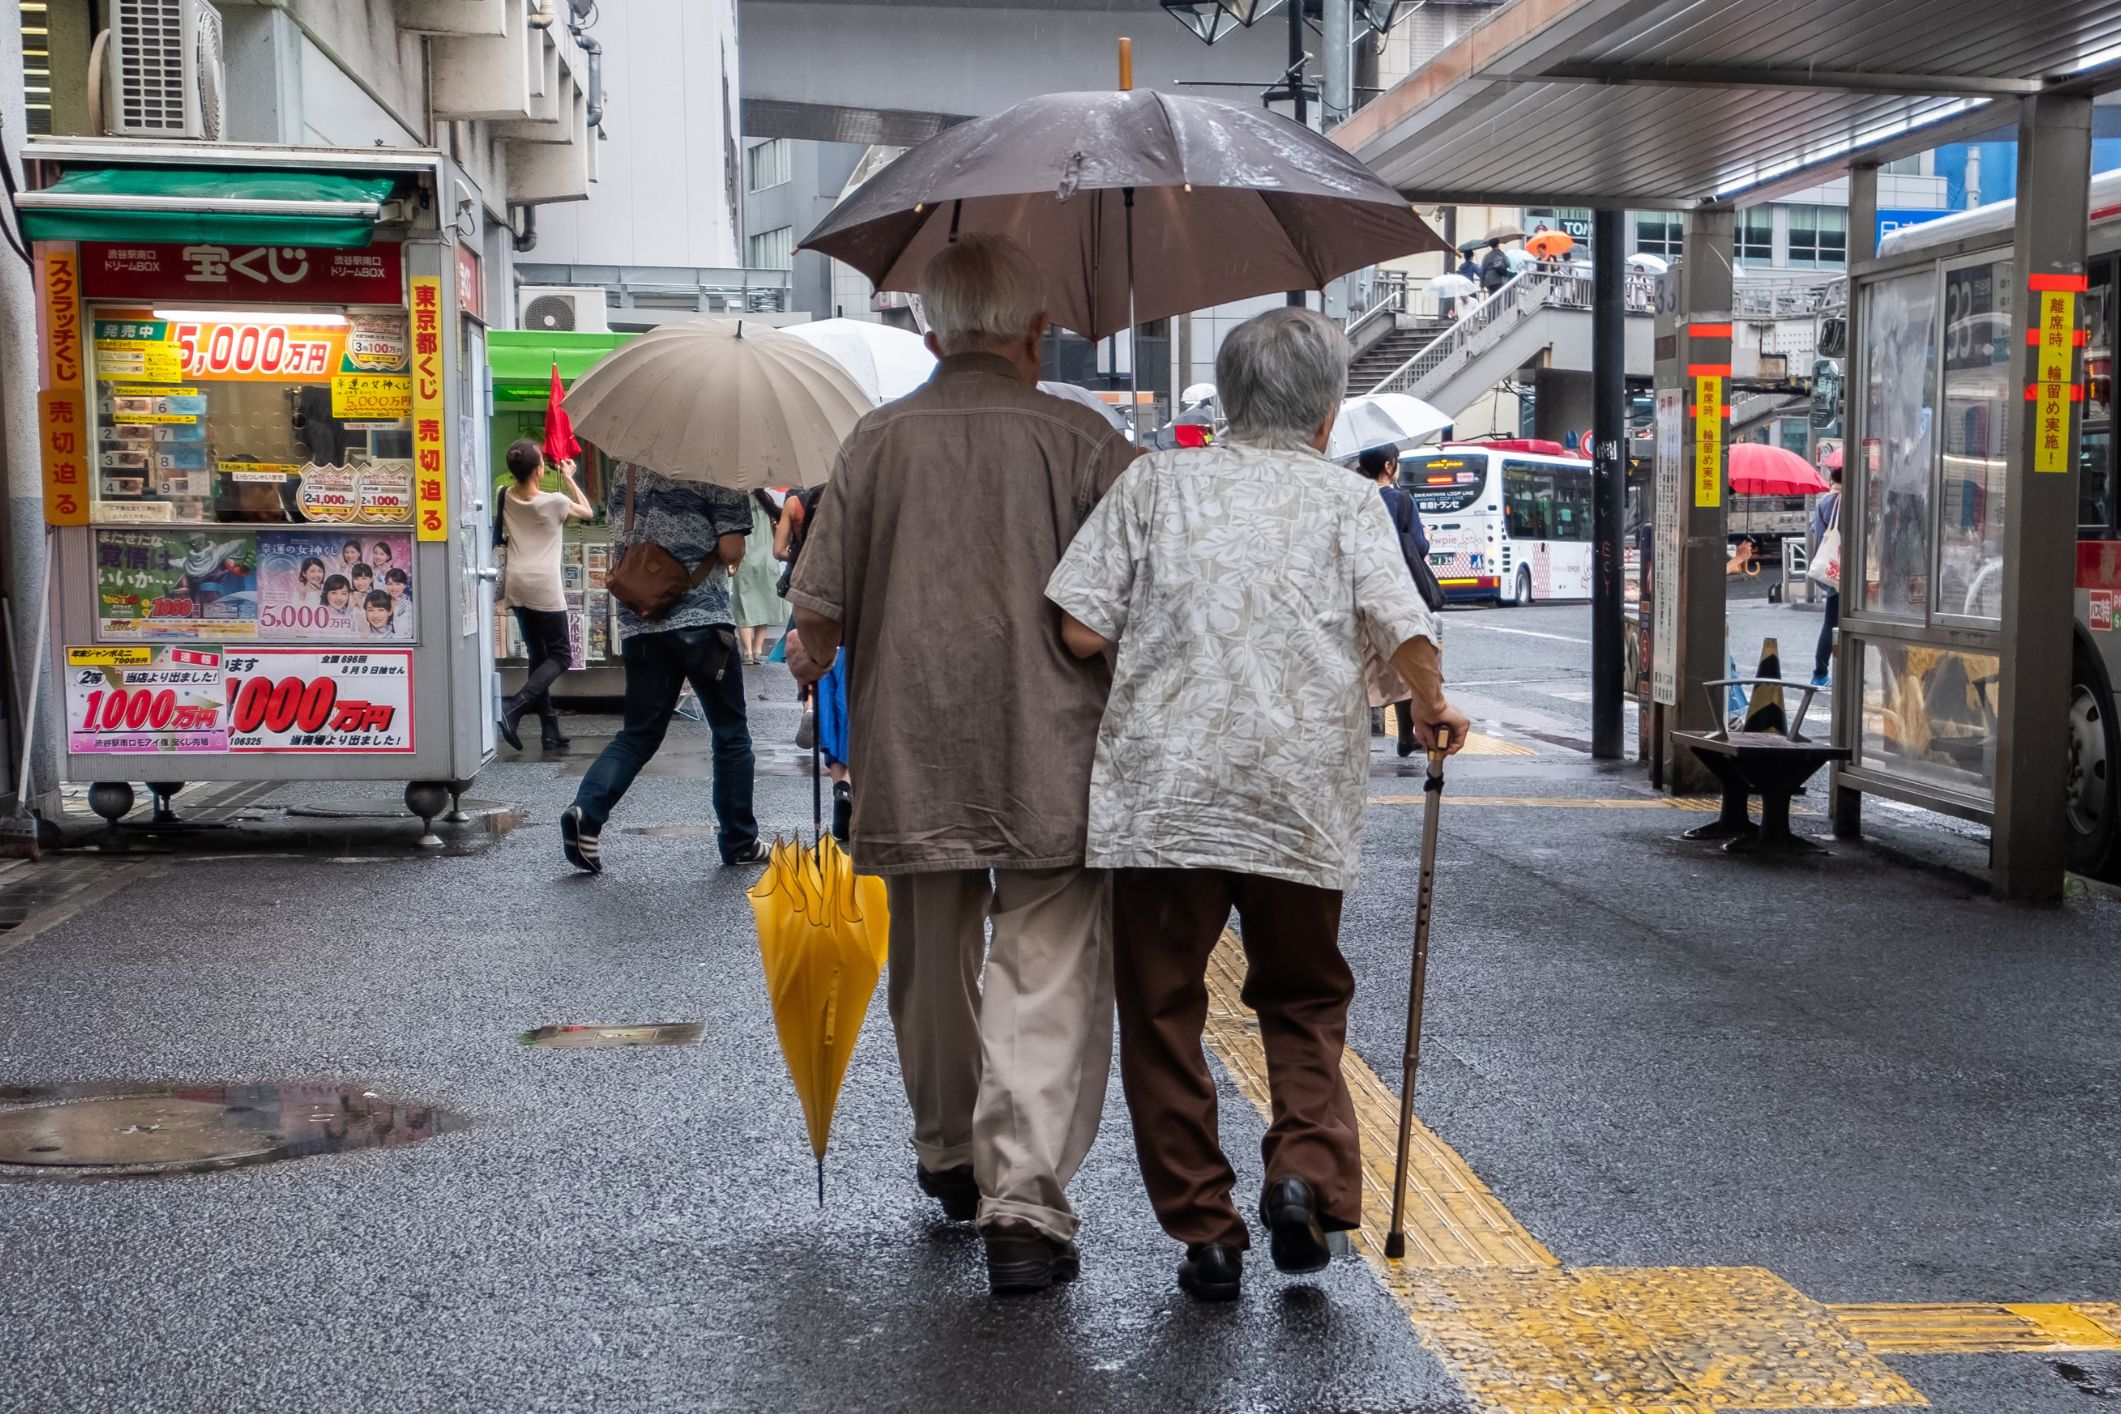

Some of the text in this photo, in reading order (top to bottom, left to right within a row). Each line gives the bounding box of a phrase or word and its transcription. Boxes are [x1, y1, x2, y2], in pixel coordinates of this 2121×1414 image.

[104, 260, 160, 272] ドリームBOX
[182, 244, 309, 284] 宝くじ
[331, 266, 385, 278] ドリームBOX
[50, 260, 77, 381] スクラッチくじ
[103, 324, 154, 339] 発売中
[414, 285, 437, 400] 東京都くじ
[176, 323, 329, 376] 5,000万円
[104, 403, 109, 412] 1
[158, 403, 167, 413] 6
[104, 429, 112, 439] 2
[160, 430, 167, 440] 7
[49, 401, 78, 515] 売切迫る
[105, 456, 113, 466] 3
[161, 457, 169, 467] 8
[418, 419, 442, 531] 売切迫る
[105, 483, 114, 492] 4
[162, 483, 170, 493] 9
[261, 543, 340, 556] 幸運の女神くじ
[260, 605, 350, 629] 5,000万円
[79, 671, 103, 684] 2等
[125, 671, 217, 684] 当店より出ました!
[82, 688, 219, 733] 1,000万円
